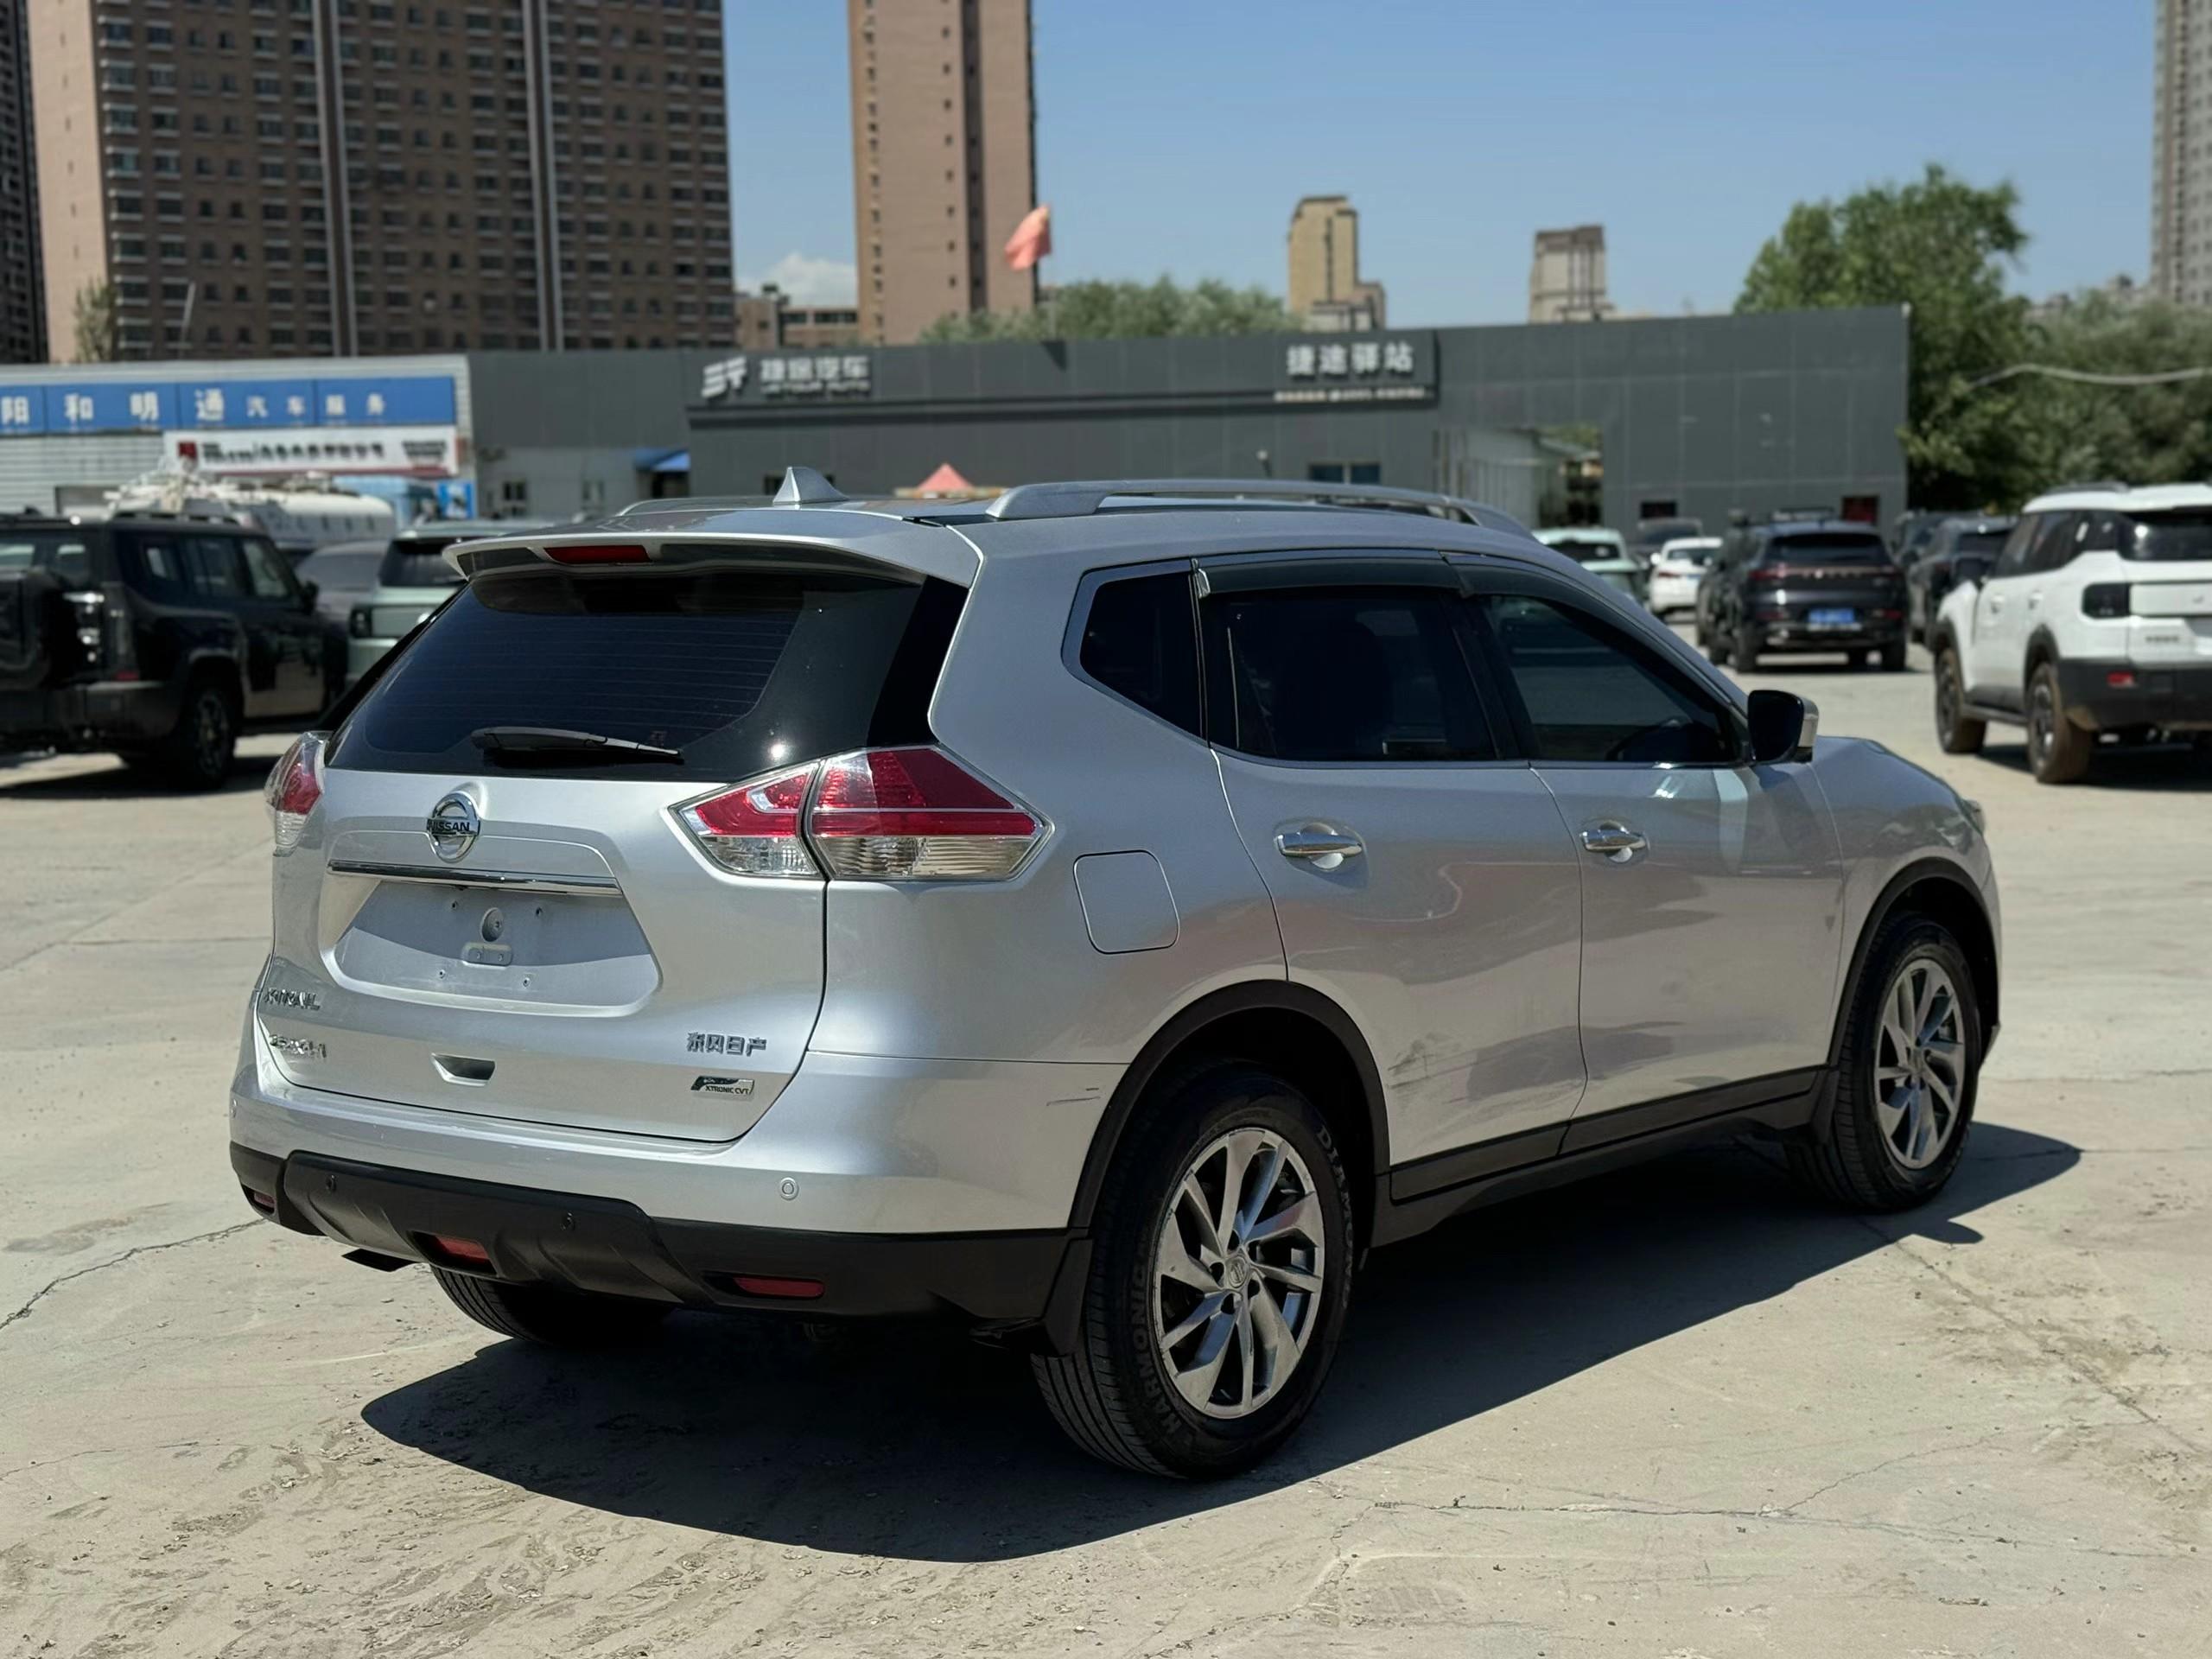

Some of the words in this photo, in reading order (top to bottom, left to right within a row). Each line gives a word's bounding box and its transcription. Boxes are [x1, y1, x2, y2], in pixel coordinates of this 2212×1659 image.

[686, 1032, 767, 1057] 东风日产
[705, 1084, 734, 1094] XTRONIC
